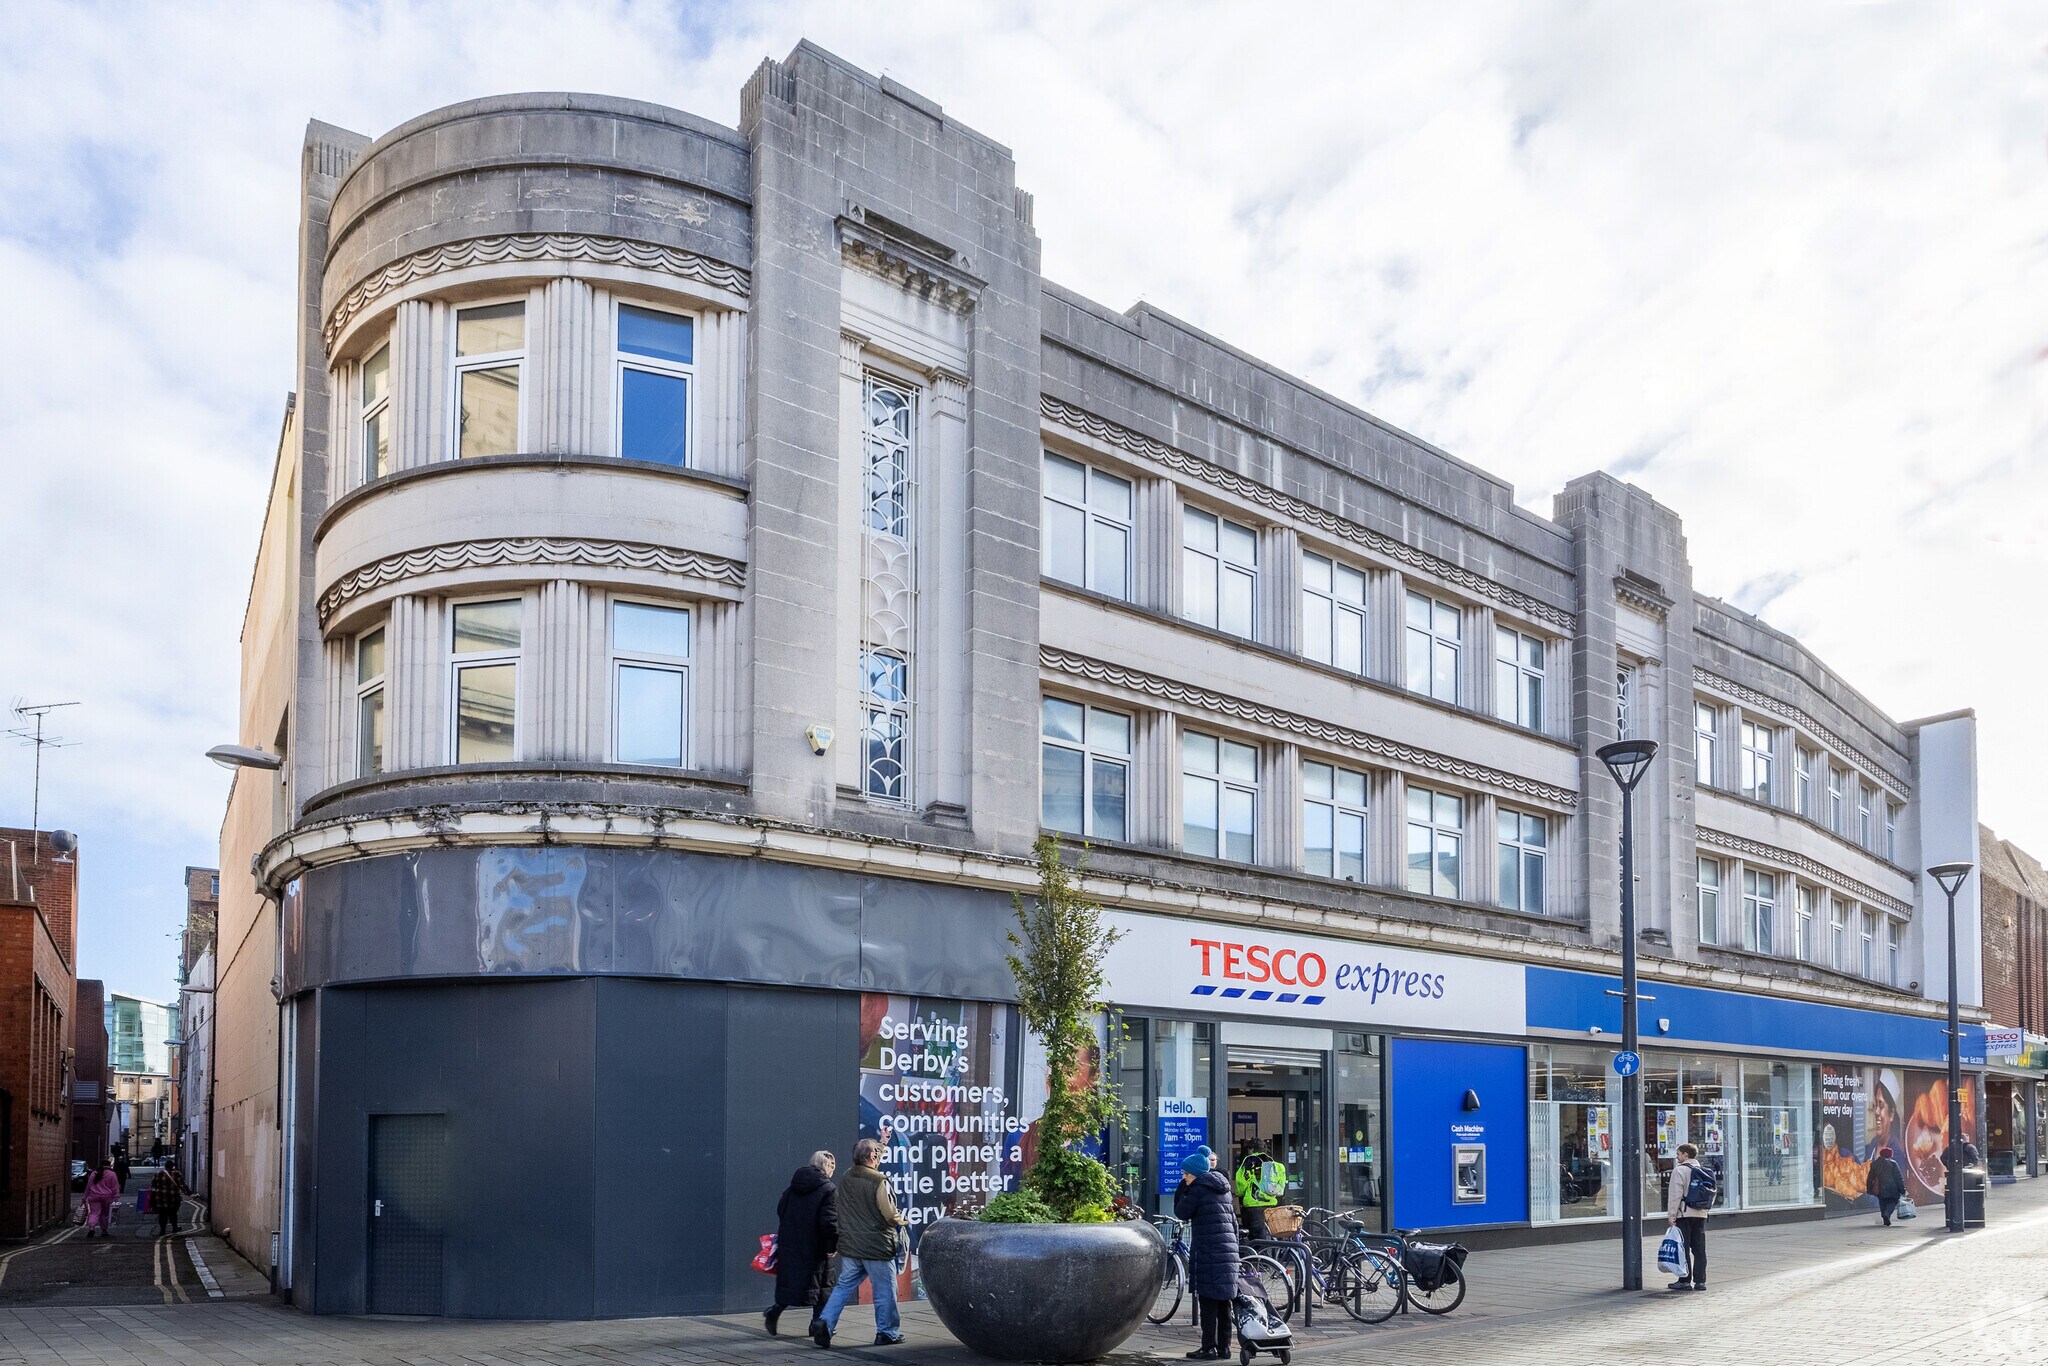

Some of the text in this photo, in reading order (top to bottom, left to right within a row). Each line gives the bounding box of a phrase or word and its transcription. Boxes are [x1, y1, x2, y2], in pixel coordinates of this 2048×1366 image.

[1190, 938, 1445, 1005] TESCO express
[879, 1016, 968, 1049] Serving
[880, 1047, 969, 1078] Derby’s
[1823, 1073, 1860, 1089] Baking fresh
[879, 1081, 1009, 1108] customers,
[1823, 1088, 1868, 1101] from our ovens
[1164, 1100, 1196, 1114] Hello.
[1823, 1104, 1853, 1118] every day
[879, 1110, 1030, 1134] communities
[1451, 1125, 1484, 1133] Cash Machine
[1164, 1133, 1178, 1141] 7am
[1184, 1133, 1202, 1143] 10pm
[880, 1140, 1022, 1169] and planet a
[880, 1170, 1013, 1194] ittle better
[898, 1206, 947, 1225] very
